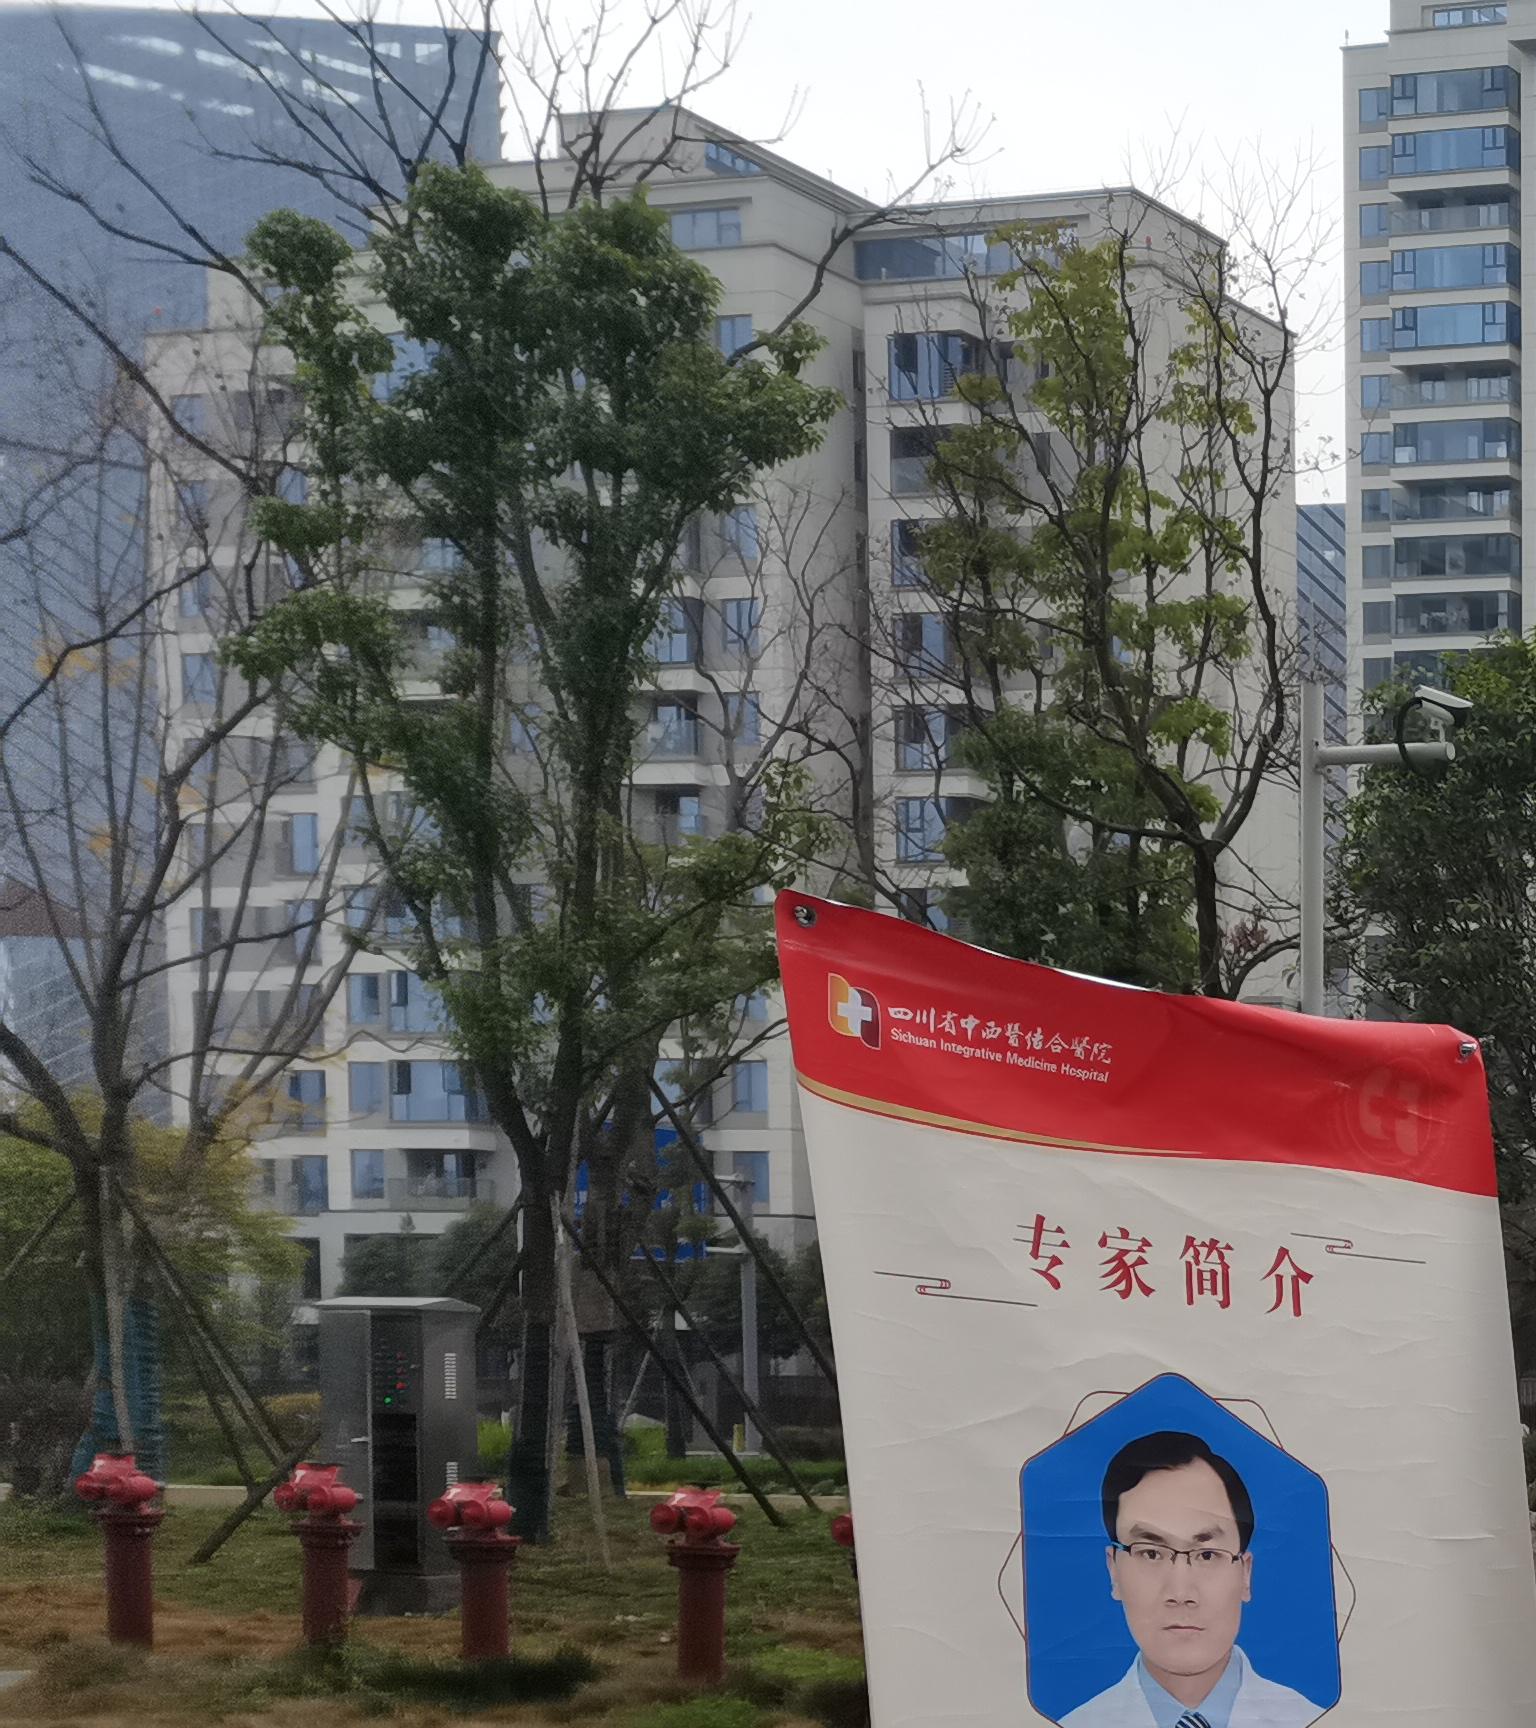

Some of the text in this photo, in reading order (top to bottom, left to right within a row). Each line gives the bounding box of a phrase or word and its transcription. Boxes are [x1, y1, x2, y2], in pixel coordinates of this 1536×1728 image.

[891, 1028, 1109, 1083] Sichuan Integrative Medicine Hospital
[1013, 1213, 1314, 1316] 专家简介
